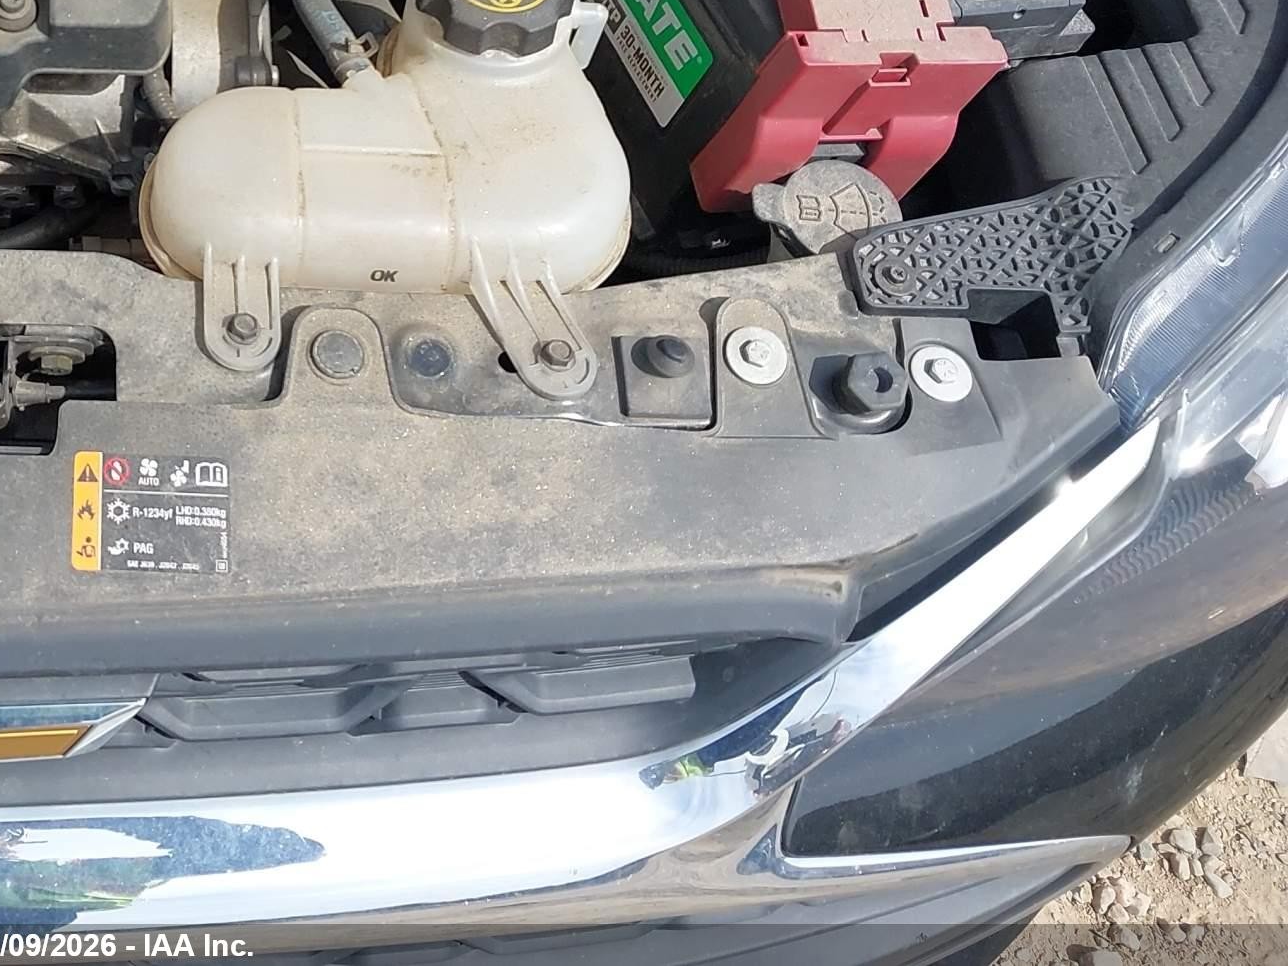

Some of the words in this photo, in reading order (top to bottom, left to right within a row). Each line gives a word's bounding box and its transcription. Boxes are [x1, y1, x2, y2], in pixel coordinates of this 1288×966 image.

[620, 25, 665, 97] 30-MONTH
[370, 269, 399, 282] OK
[138, 477, 160, 486] AUTO
[132, 507, 173, 520] R-1234yf
[133, 542, 154, 554] PAG
